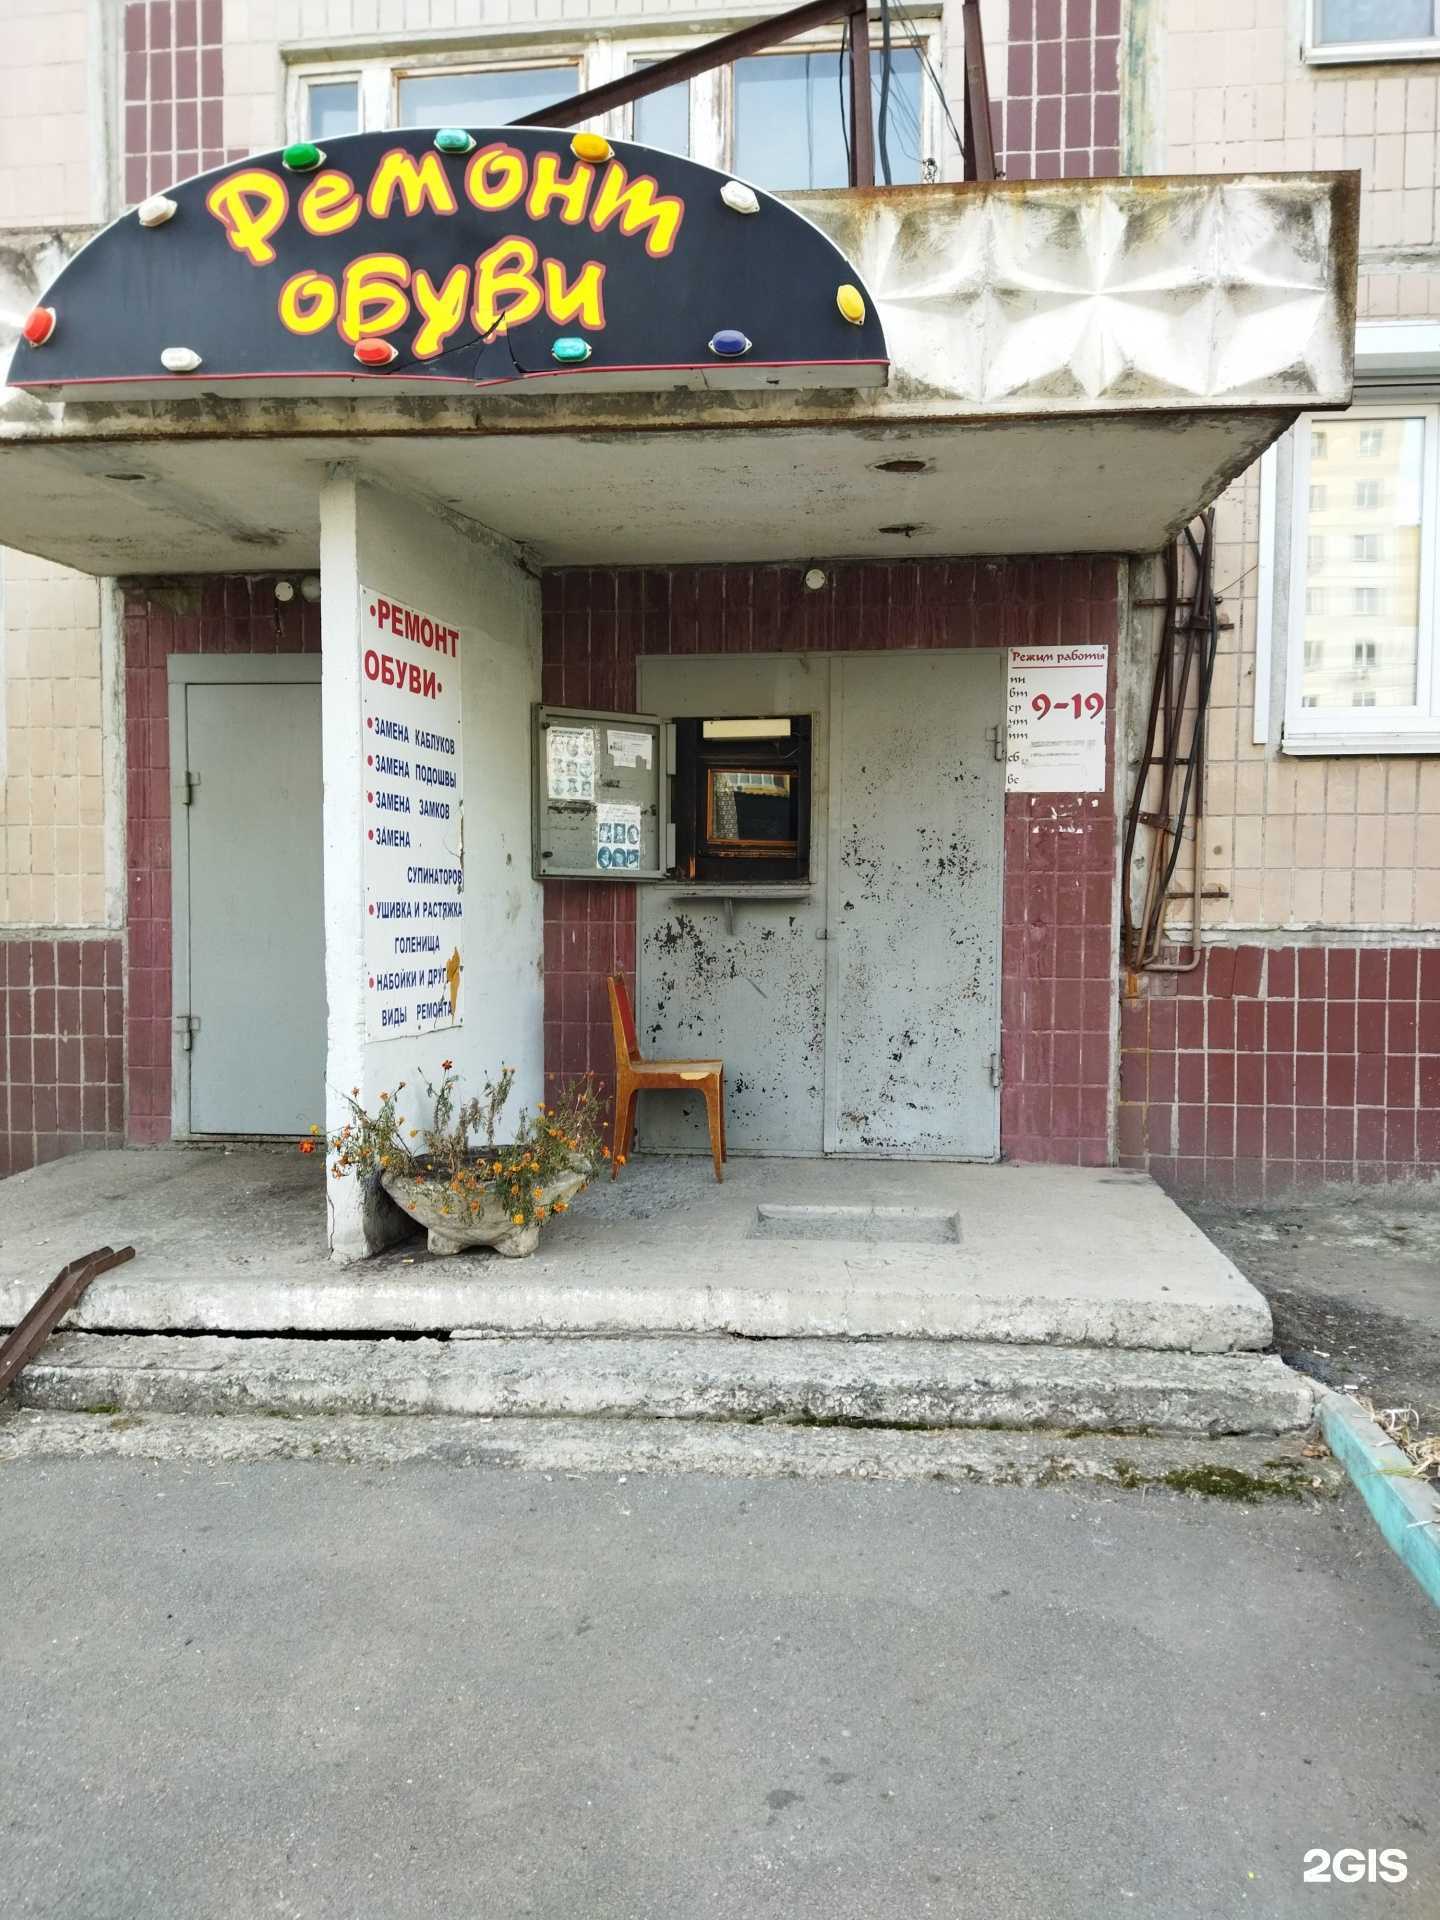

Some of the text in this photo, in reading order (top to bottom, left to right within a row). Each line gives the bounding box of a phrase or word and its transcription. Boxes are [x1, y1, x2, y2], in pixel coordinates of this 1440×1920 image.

[207, 142, 684, 266] Ремонт
[377, 598, 459, 658] РЕМОНТ
[1012, 649, 1105, 663] Режим работы
[364, 649, 436, 700] ОБУВИ
[1008, 704, 1022, 714] ср
[1031, 692, 1105, 721] 9-19
[374, 717, 455, 755] ЗАМЕНА КАБЛУКОВ
[1007, 751, 1020, 762] сб
[375, 755, 457, 788] ЗАМЕНА ПОДОШВЫ
[375, 791, 450, 820] ЗАМЕНА ЗАМКОВ
[375, 827, 411, 848] ЗАМЕНА
[407, 866, 462, 885] СУПИНАТОРОВ
[376, 901, 463, 919] УШИВКА И РАСТЯЖКА
[394, 936, 440, 954] ГОЛЕНИЩА
[376, 971, 417, 992] НАБОЙКИ
[419, 969, 425, 986] И
[381, 1000, 454, 1027] ВИДЫ РЕМОНТА
